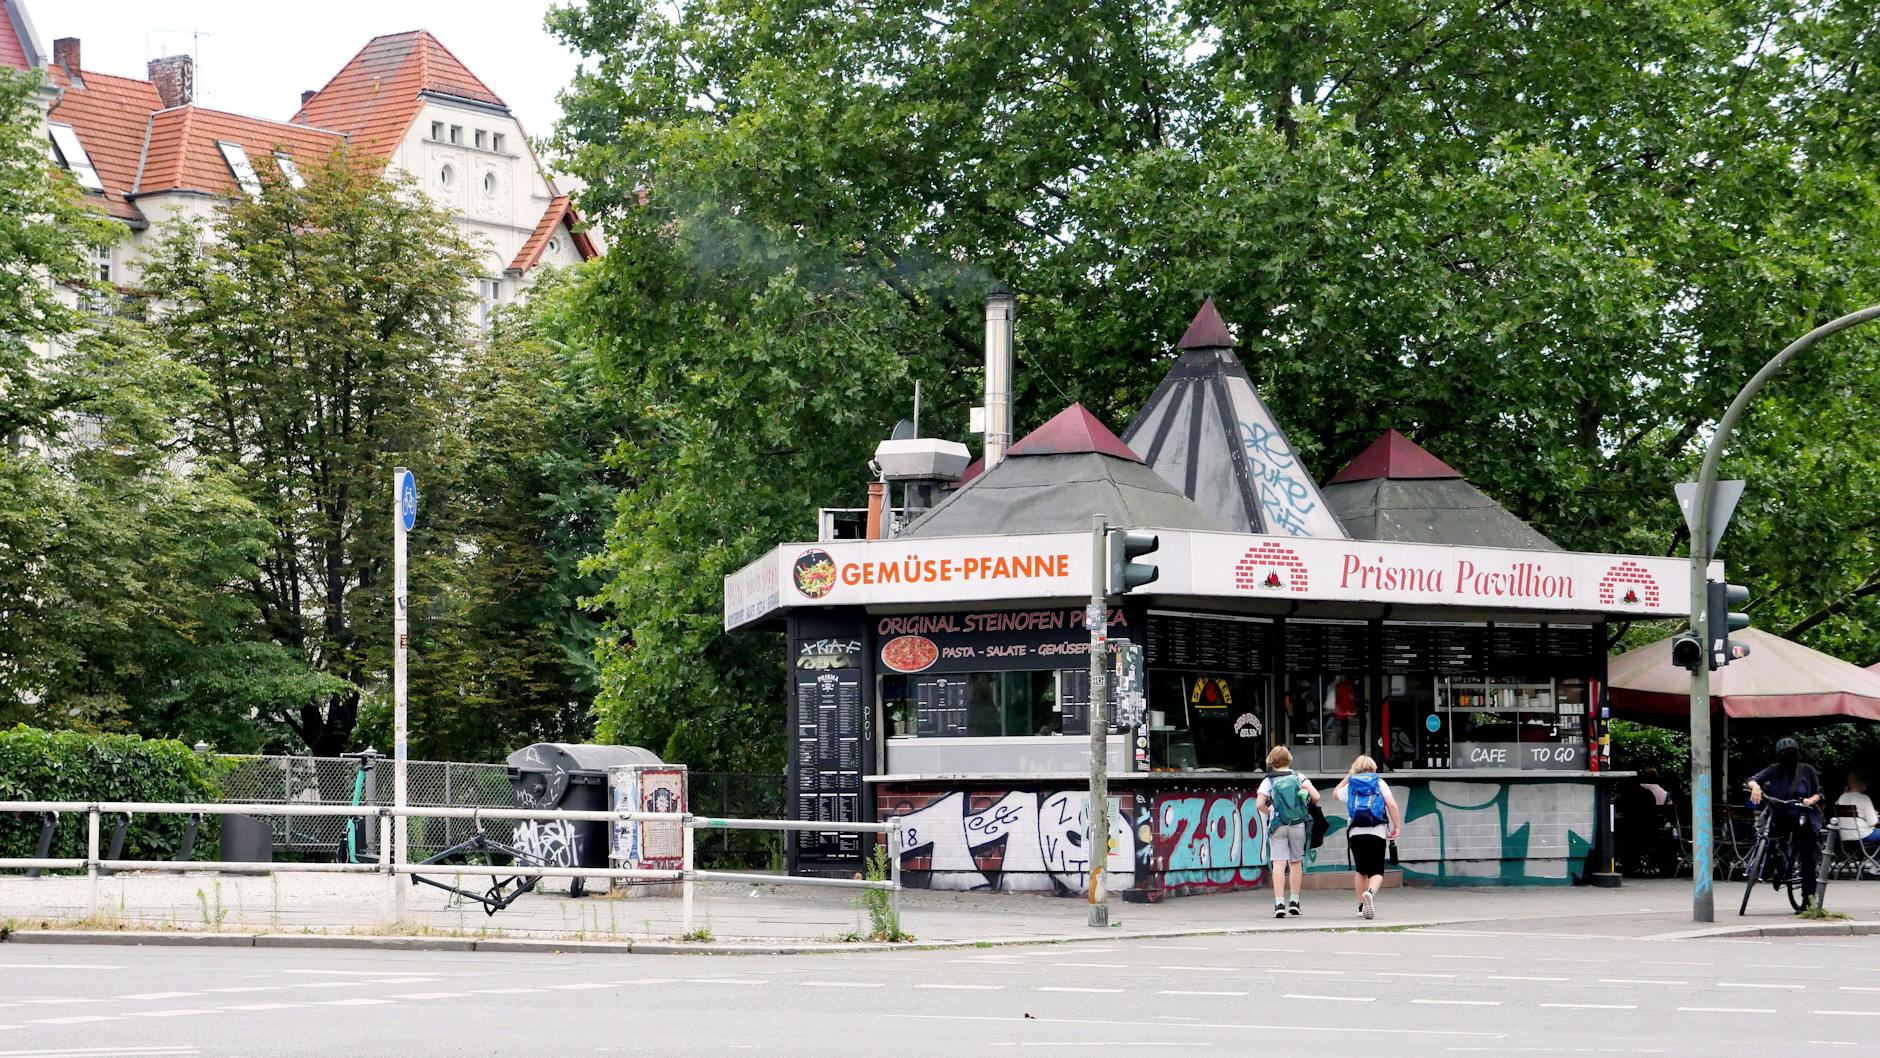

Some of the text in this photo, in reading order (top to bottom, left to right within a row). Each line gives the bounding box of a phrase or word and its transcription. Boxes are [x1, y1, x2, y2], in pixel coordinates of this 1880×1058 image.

[841, 554, 1069, 586] GEMÜSE-PFANNE
[1339, 554, 1575, 598] Prisma Pavillion
[878, 608, 1128, 636] ORIGINAL STEINOFEN PIZA
[942, 646, 976, 658] PASTA
[986, 644, 1027, 657] SALATE
[1471, 748, 1507, 763] CAFE
[1530, 748, 1575, 763] TO GO
